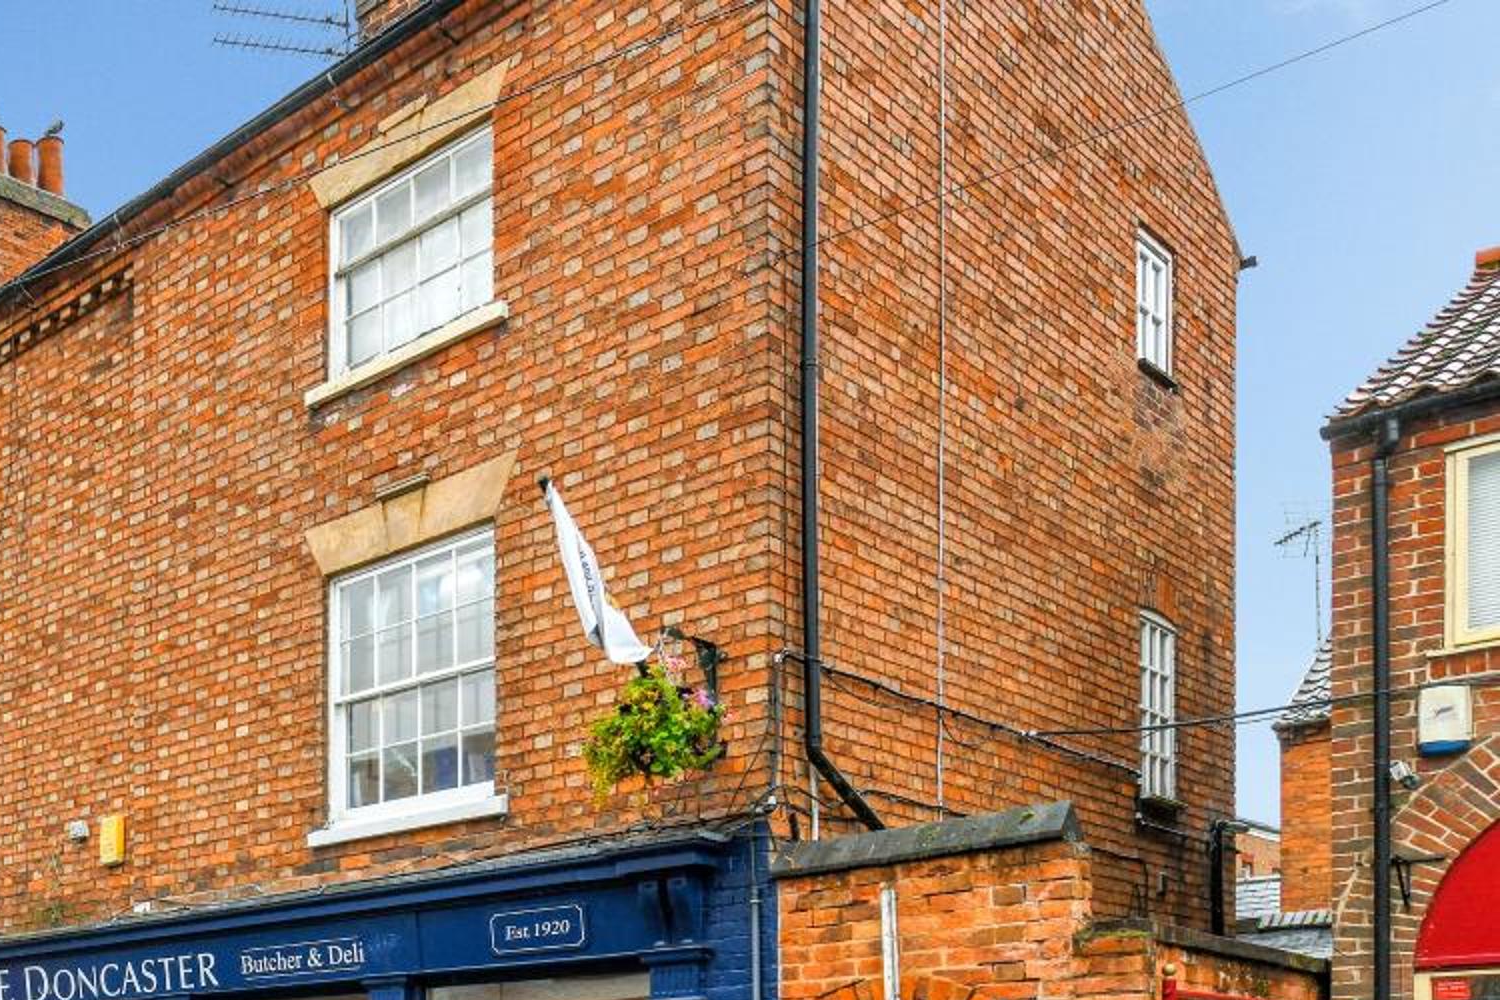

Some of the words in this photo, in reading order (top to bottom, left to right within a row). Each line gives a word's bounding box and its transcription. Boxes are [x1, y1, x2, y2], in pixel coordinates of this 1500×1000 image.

[534, 919, 571, 937] 1920
[240, 952, 303, 975] Butcher
[307, 947, 323, 968] &
[328, 941, 365, 965] Deli
